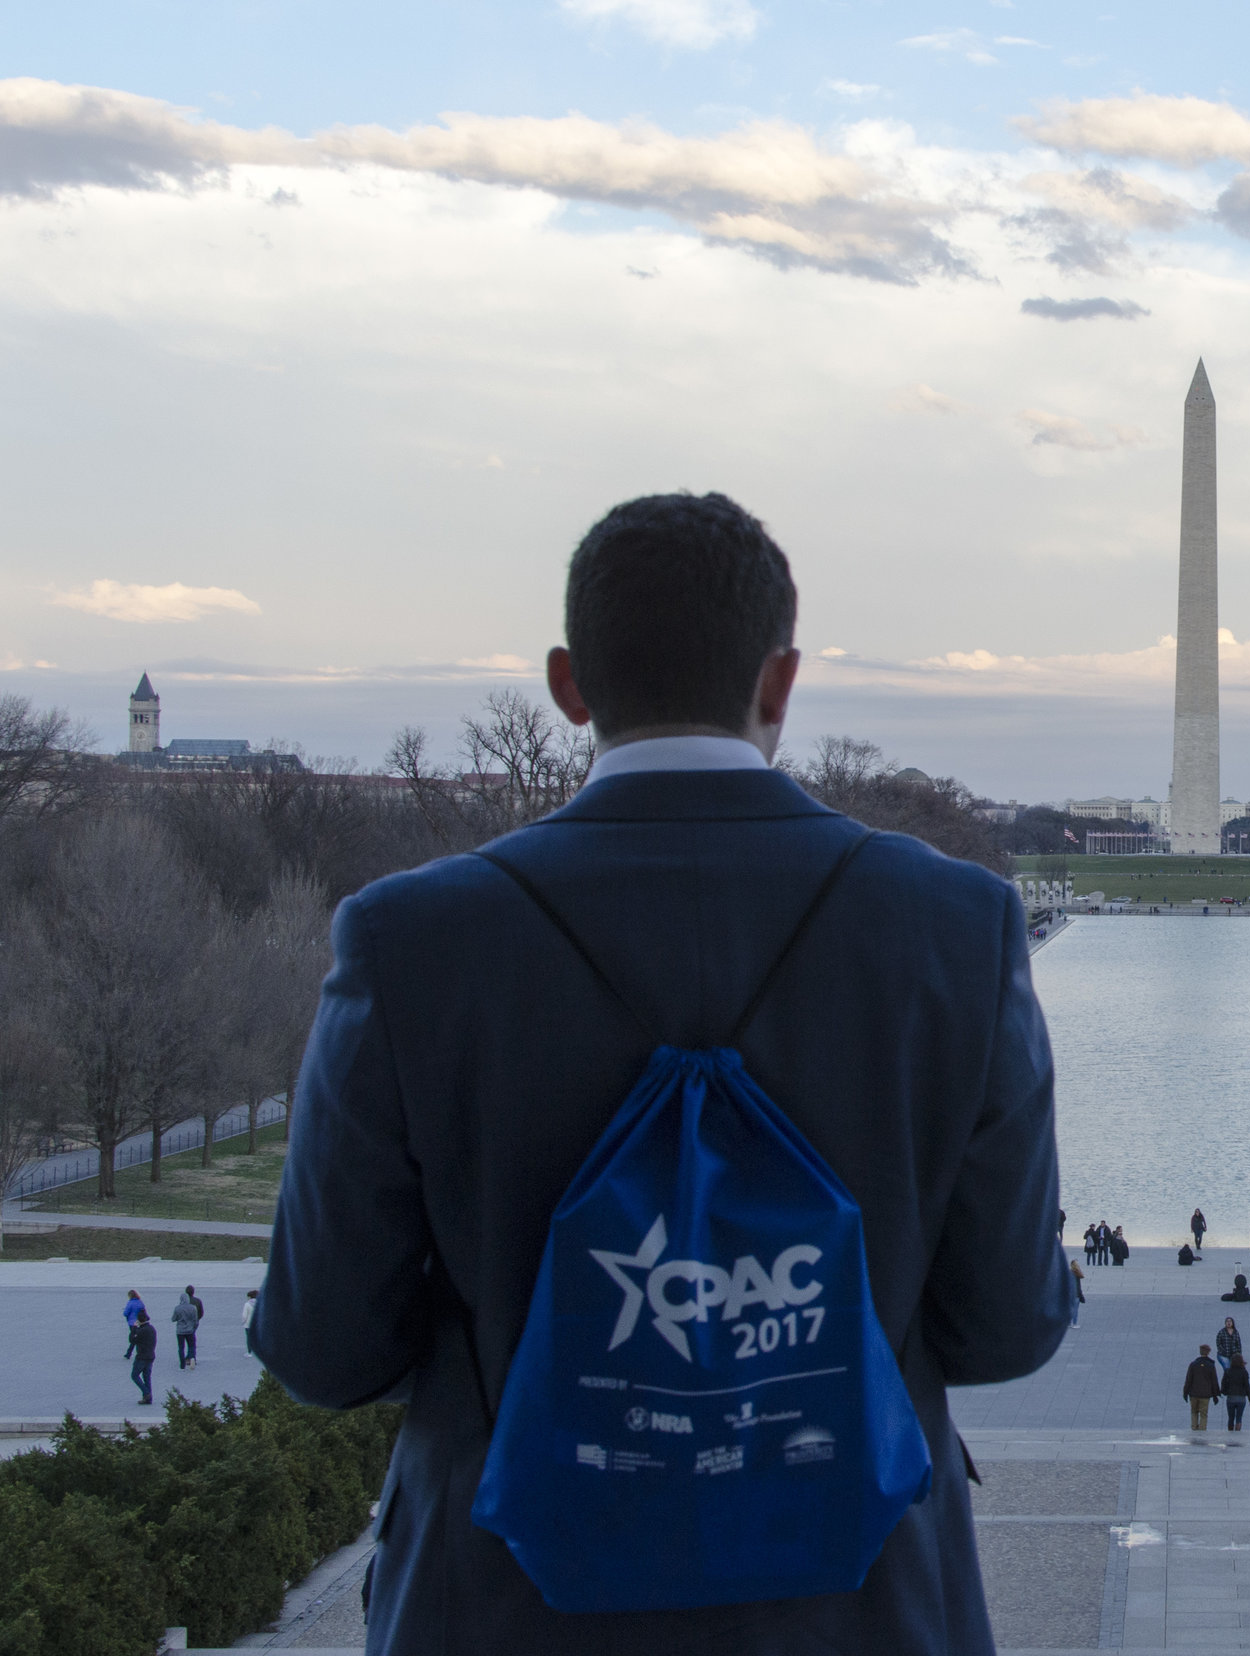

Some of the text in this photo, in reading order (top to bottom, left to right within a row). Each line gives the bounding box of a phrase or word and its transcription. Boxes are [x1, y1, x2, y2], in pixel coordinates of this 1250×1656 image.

[647, 1244, 823, 1322] CPAC
[731, 1306, 825, 1359] 2017
[651, 1411, 694, 1434] NRA
